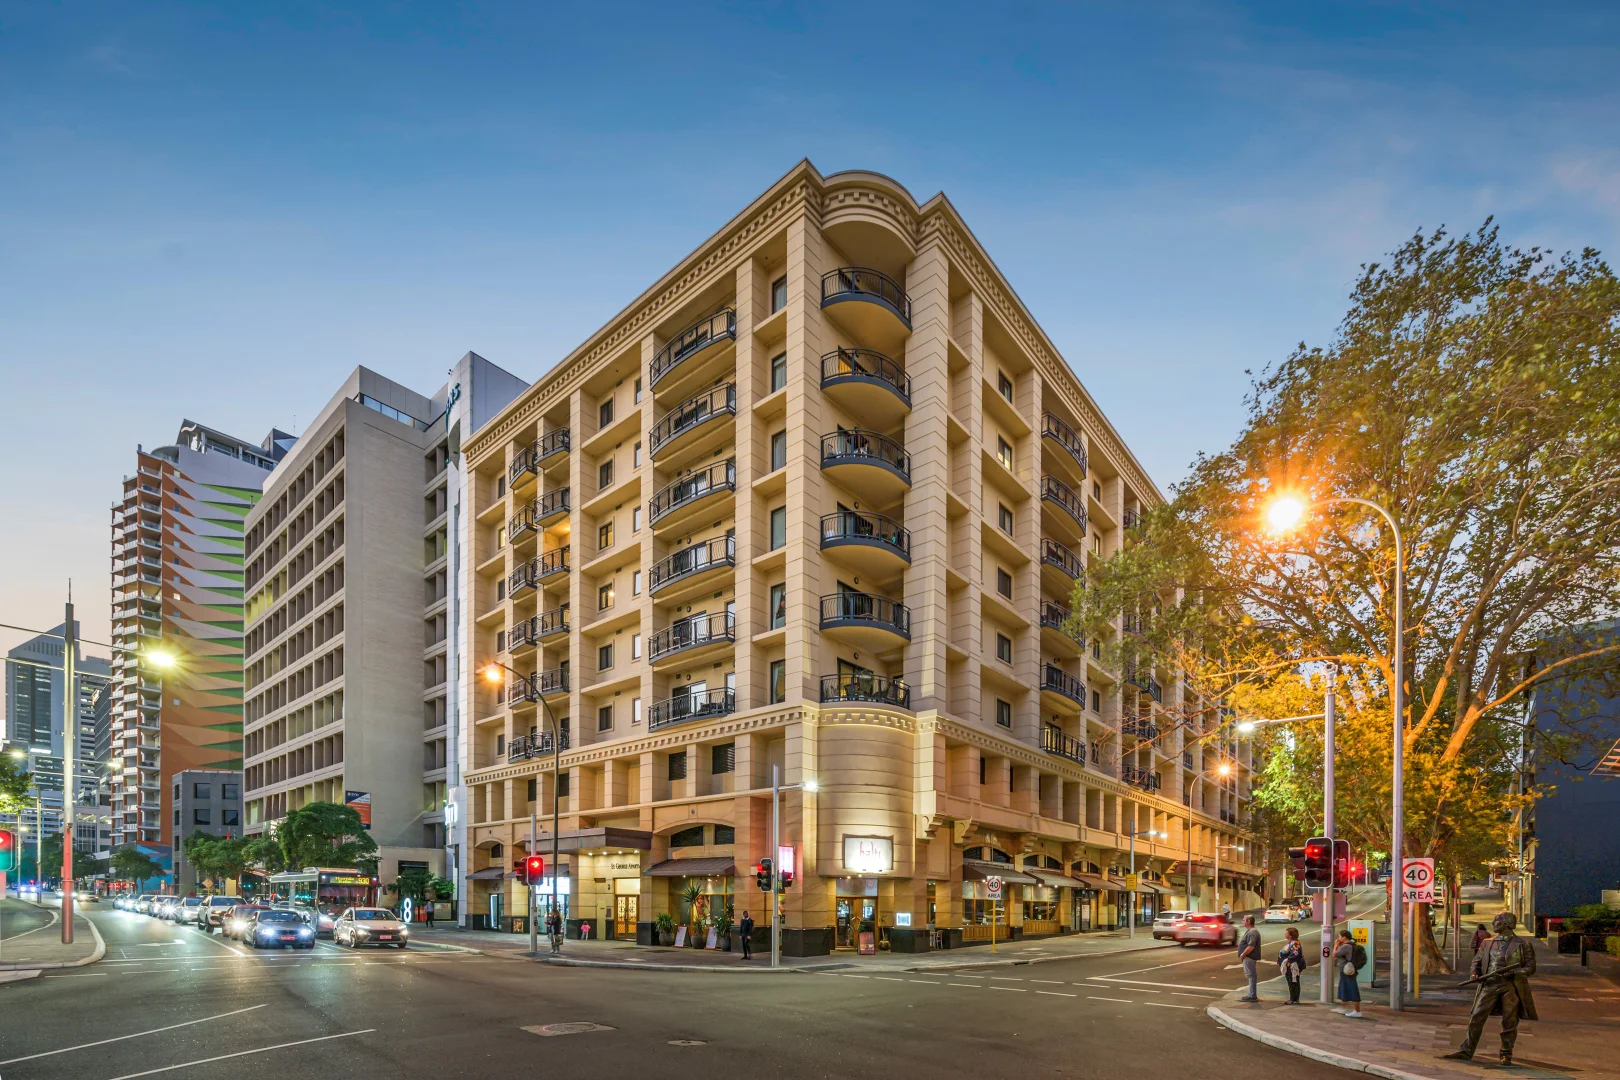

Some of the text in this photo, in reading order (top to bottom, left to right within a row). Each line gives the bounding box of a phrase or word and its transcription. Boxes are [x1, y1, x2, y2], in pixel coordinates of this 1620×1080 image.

[1406, 869, 1428, 881] 40
[358, 877, 370, 885] 930
[989, 881, 999, 889] 40
[1402, 891, 1433, 900] AREA
[403, 897, 412, 922] 8
